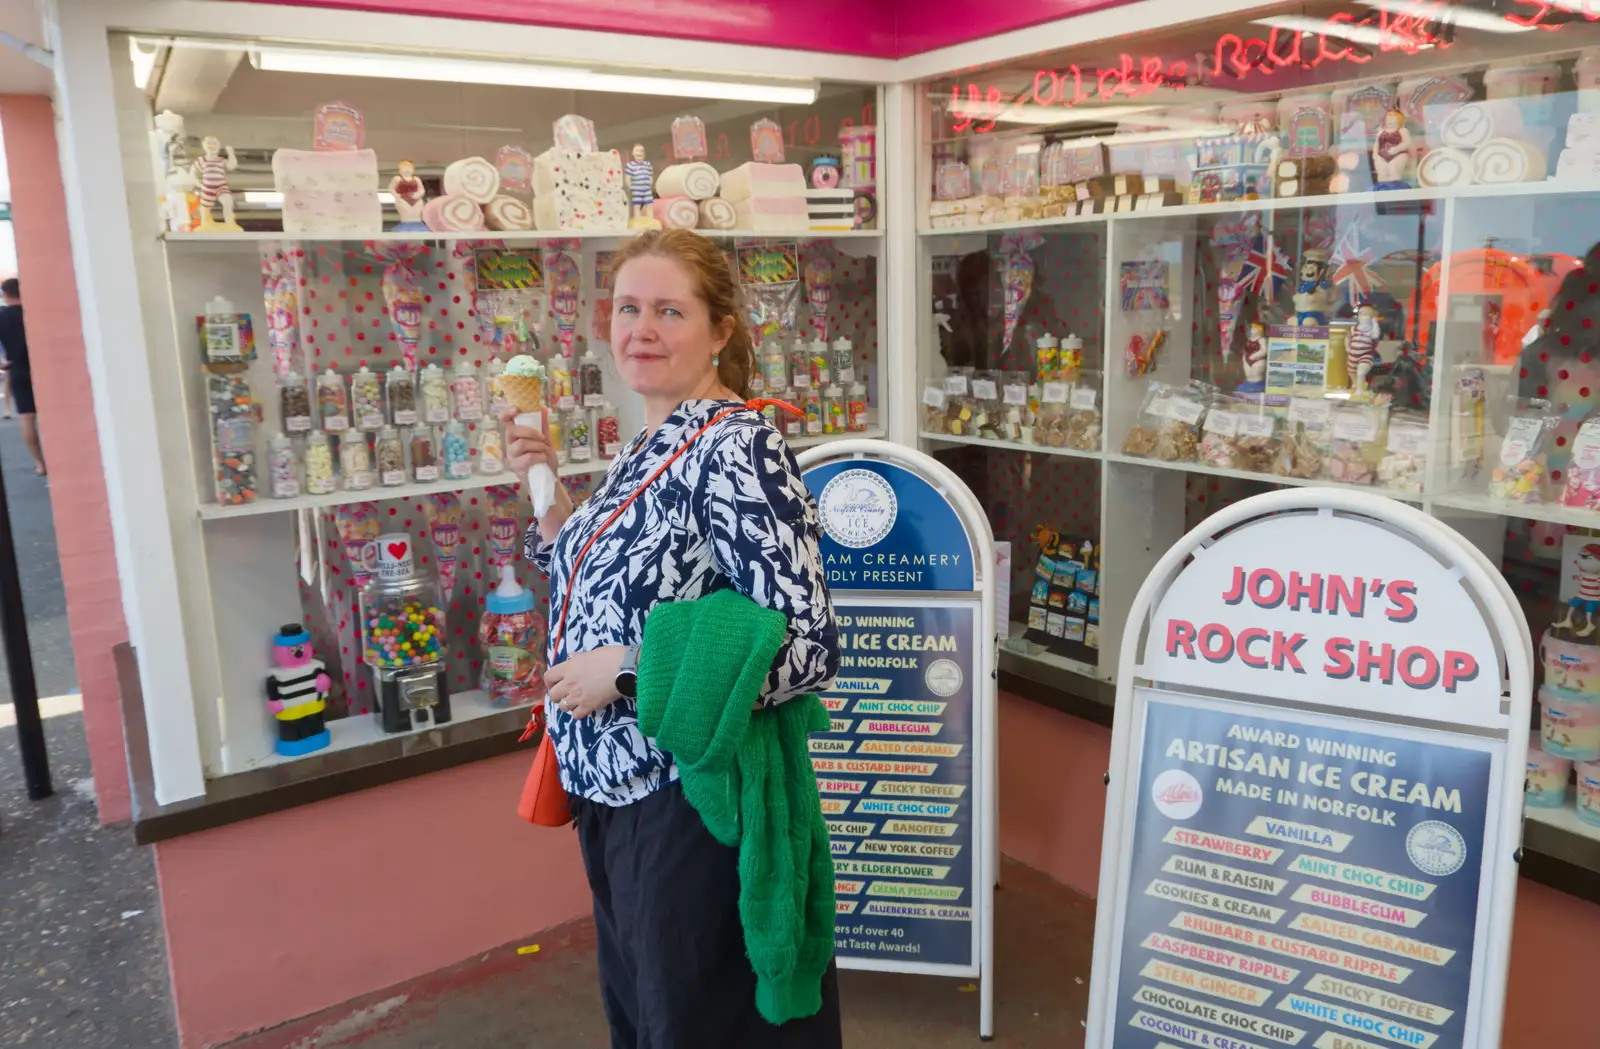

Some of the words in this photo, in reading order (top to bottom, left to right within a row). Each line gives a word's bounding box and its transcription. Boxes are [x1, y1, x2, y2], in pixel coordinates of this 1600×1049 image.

[848, 518, 868, 528] ICE
[862, 553, 960, 566] CREAMERY
[863, 571, 923, 582] PRESENT
[1222, 566, 1418, 623] JOHN'S
[856, 616, 915, 628] WINNING
[853, 634, 881, 650] ICE
[886, 634, 957, 652] CREAM
[841, 656, 854, 667] IN
[857, 657, 918, 669] NORFOLK
[1165, 619, 1308, 675] ROCK
[1323, 637, 1480, 693] SHOP
[835, 680, 880, 690] VANILLA
[858, 701, 884, 711] MINT
[887, 702, 913, 712] CHOC
[917, 703, 940, 713] CHIP
[868, 722, 931, 733] BUBBLEGUM
[812, 742, 845, 751] CREAM
[864, 743, 901, 752] SALTED
[904, 744, 955, 755] CARAMEL
[1227, 724, 1300, 749] AWARD
[1305, 737, 1397, 767] WINNING
[846, 762, 891, 772] CUSTARD
[894, 763, 929, 774] RIPPLE
[1165, 738, 1291, 780] ARTISAN
[1297, 760, 1343, 790] ICE
[1350, 771, 1463, 814] CREAM
[826, 782, 861, 792] RIPPLE
[881, 783, 916, 793] STICKY
[919, 785, 955, 795] TOFFEE
[862, 802, 894, 812] WHITE
[897, 803, 924, 813] CHOC
[927, 804, 950, 814] CHIP
[1216, 777, 1272, 801] MADE
[1277, 789, 1298, 806] IN
[1303, 794, 1397, 827] NORFOLK
[845, 824, 867, 834] CHIP
[893, 823, 946, 834] BANOFFEE
[1265, 821, 1333, 847] VANILLA
[865, 842, 887, 852] NEW
[890, 843, 917, 853] YORK
[920, 844, 955, 856] COFFEE
[1175, 831, 1273, 861] STRAWBERRY
[852, 863, 858, 871] &
[861, 864, 934, 876] ELDERFLOWER
[1174, 859, 1206, 877] RUM
[1211, 868, 1219, 880] &
[1222, 870, 1274, 893] RAISIN
[1299, 857, 1338, 877] MINT
[1342, 867, 1383, 886] CHOC
[1388, 879, 1425, 896] CHIP
[872, 885, 905, 894] CREMA
[908, 886, 957, 897] PISTACHIO
[1154, 882, 1209, 905] COOKIES
[1212, 897, 1220, 908] &
[1224, 899, 1272, 921] CREAM
[1311, 890, 1406, 924] BUBBLEGUM
[869, 905, 927, 916] BLUEBERRIES
[937, 909, 970, 919] CREAM
[852, 925, 864, 934] of
[865, 928, 888, 937] over
[890, 928, 904, 937] 40
[849, 939, 876, 950] Taste
[878, 942, 921, 953] Awards!
[1301, 916, 1358, 940] SALTED
[1362, 931, 1441, 963] CARAMEL
[1183, 915, 1254, 943] RHUBARB
[1258, 935, 1266, 946] &
[1271, 936, 1339, 964] CUSTARD
[1343, 956, 1398, 981] RIPPLE
[1151, 935, 1236, 967] RASPBERRY
[1239, 957, 1290, 982] RIPPLE
[1154, 963, 1195, 986] STEM
[1200, 977, 1259, 1003] GINGER
[1320, 979, 1375, 1004] STICKY
[1379, 995, 1435, 1021] TOFFEE
[1141, 989, 1217, 1021] CHOCOLATE
[1221, 1012, 1259, 1032] CHOC
[1261, 1024, 1295, 1042] CHIP
[1290, 997, 1338, 1022] WHITE
[1343, 1012, 1384, 1034] CHOC
[1388, 1026, 1425, 1045] CHIP
[1140, 1015, 1198, 1041] COCONUT
[1201, 1033, 1209, 1044] &
